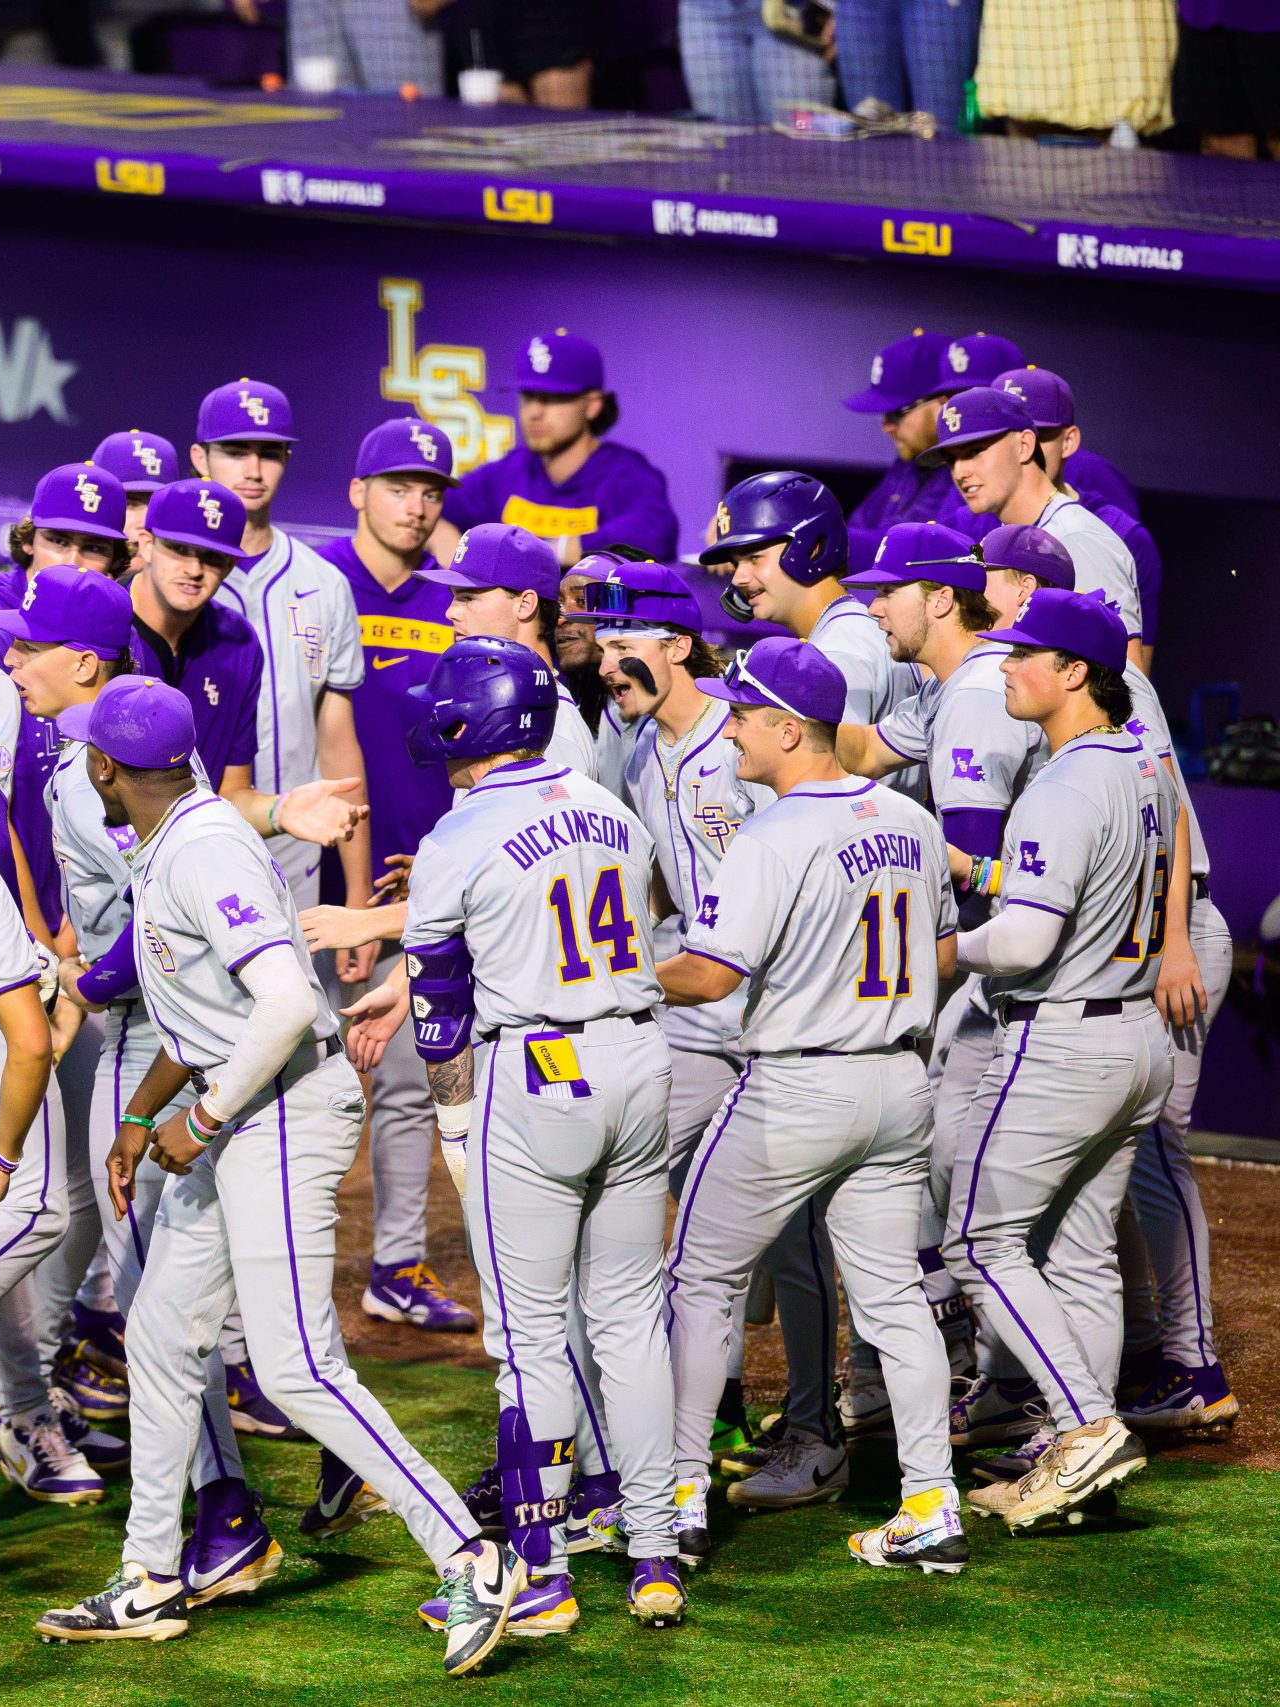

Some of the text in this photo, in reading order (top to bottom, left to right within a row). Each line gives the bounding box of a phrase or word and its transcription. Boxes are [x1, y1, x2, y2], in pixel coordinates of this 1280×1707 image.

[96, 158, 165, 195] LSU
[483, 187, 553, 224] LSU
[882, 219, 952, 257] LSU
[1100, 242, 1183, 271] RENTALS
[239, 390, 269, 426] LSU
[132, 439, 162, 476] LSU
[410, 425, 438, 462] LSU
[75, 473, 102, 513] LSU
[197, 489, 224, 531] LSU
[361, 624, 441, 645] GERS
[519, 712, 532, 729] 14
[502, 809, 630, 873] DICKINSON
[836, 833, 922, 884] PEARSON
[546, 864, 642, 987] 14
[855, 888, 913, 1002] 11
[537, 1044, 562, 1078] marucci
